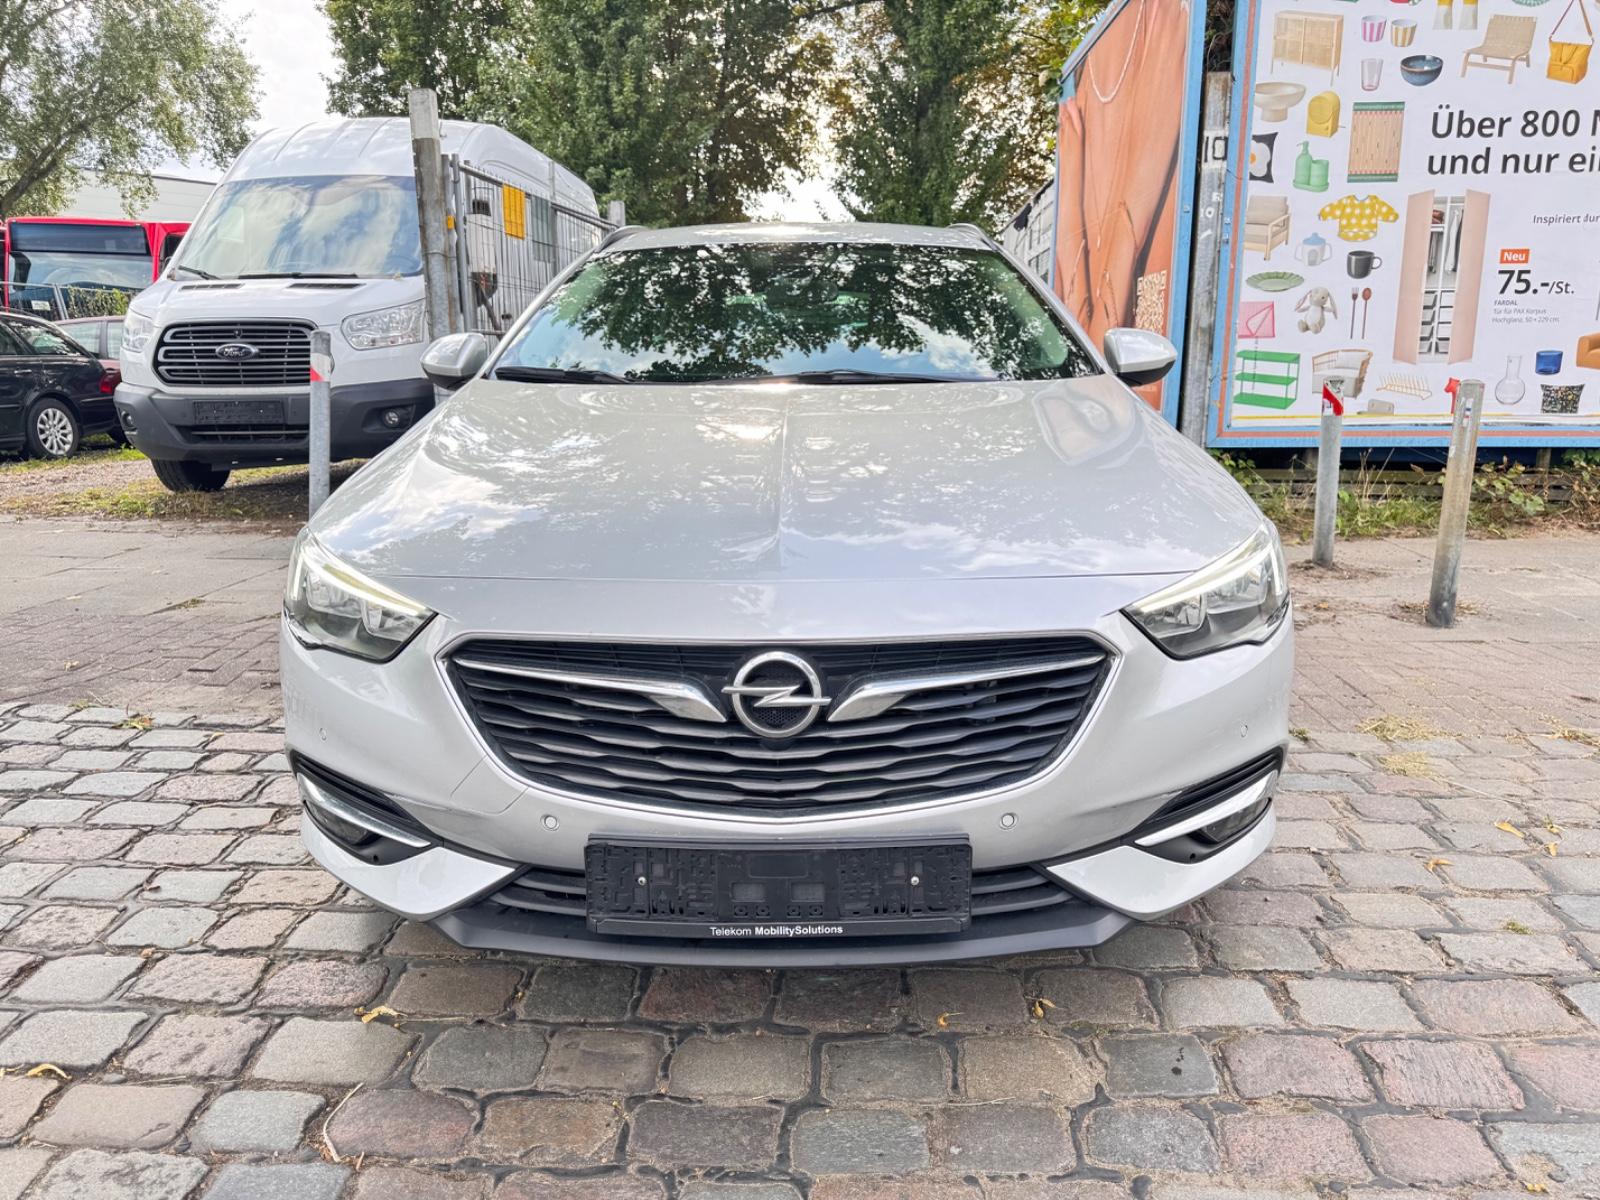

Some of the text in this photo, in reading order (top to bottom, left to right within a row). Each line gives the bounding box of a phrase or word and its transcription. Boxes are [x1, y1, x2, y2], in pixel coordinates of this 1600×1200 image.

[1431, 104, 1512, 138] Über
[1520, 109, 1581, 138] 800
[1427, 145, 1600, 175] und nur ei
[1533, 214, 1581, 226] Inspiriert
[1503, 251, 1526, 261] Neu
[709, 924, 844, 937] Telekom MobilitySolutions
